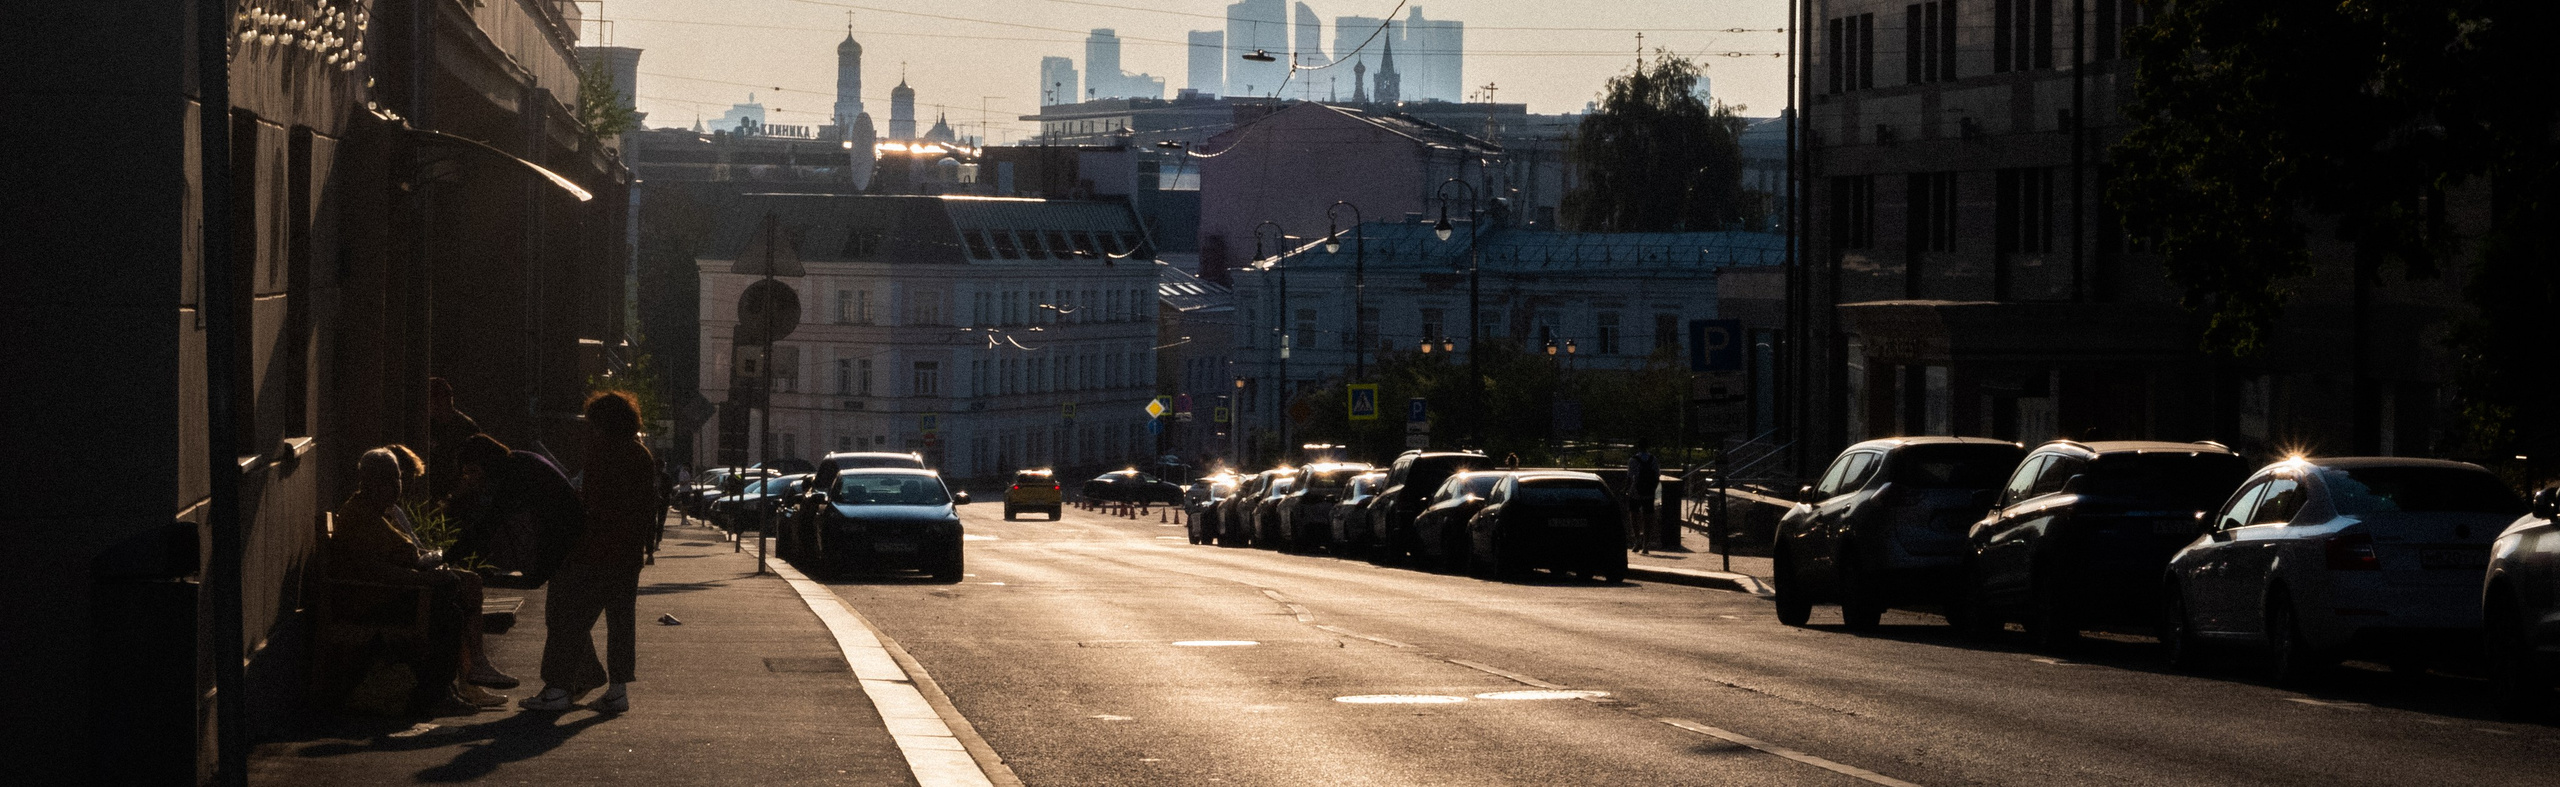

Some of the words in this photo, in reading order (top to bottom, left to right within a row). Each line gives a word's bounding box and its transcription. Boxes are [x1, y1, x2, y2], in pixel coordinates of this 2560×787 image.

[760, 123, 810, 138] КЛИНИКА
[1704, 326, 1730, 365] P
[1413, 401, 1423, 420] P
